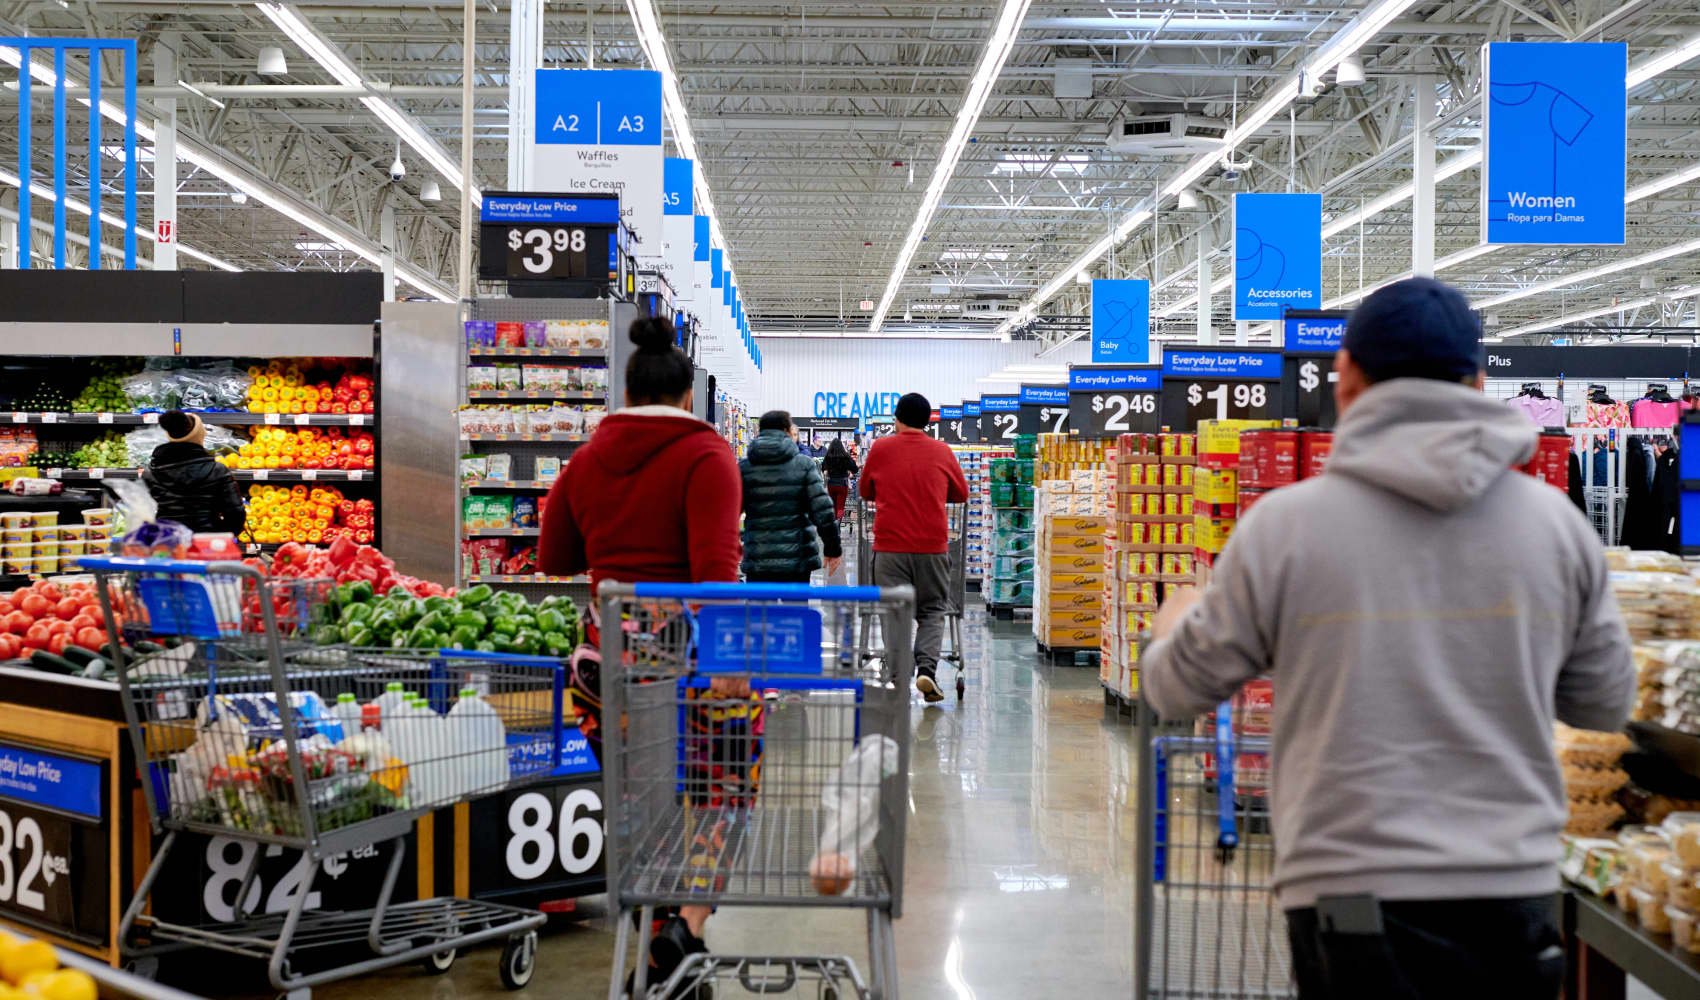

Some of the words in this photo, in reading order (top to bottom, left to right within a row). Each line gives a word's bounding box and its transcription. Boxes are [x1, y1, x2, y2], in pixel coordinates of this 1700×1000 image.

[552, 114, 580, 132] A2
[617, 115, 645, 133] A3
[577, 151, 619, 161] Waffles
[569, 178, 586, 189] Ice
[589, 178, 626, 190] Cream
[1507, 191, 1576, 209] Women
[489, 201, 531, 213] Everyday
[533, 202, 552, 212] Low
[554, 202, 578, 213] Price
[1507, 213, 1530, 224] Ropa
[1532, 215, 1552, 224] para
[1554, 213, 1585, 223] Damas
[1247, 288, 1313, 299] Accessories
[1100, 341, 1119, 351] Baby
[1172, 354, 1216, 367] Everyday
[1217, 356, 1237, 366] Low
[1238, 356, 1263, 366] Price
[1488, 355, 1512, 367] Plus
[1075, 375, 1110, 385] Everyday
[1111, 376, 1126, 384] Low
[1128, 375, 1147, 384] Price
[1025, 388, 1053, 398] Everyday
[18, 757, 37, 777] Low
[37, 760, 62, 783] Price
[506, 788, 604, 881] 86
